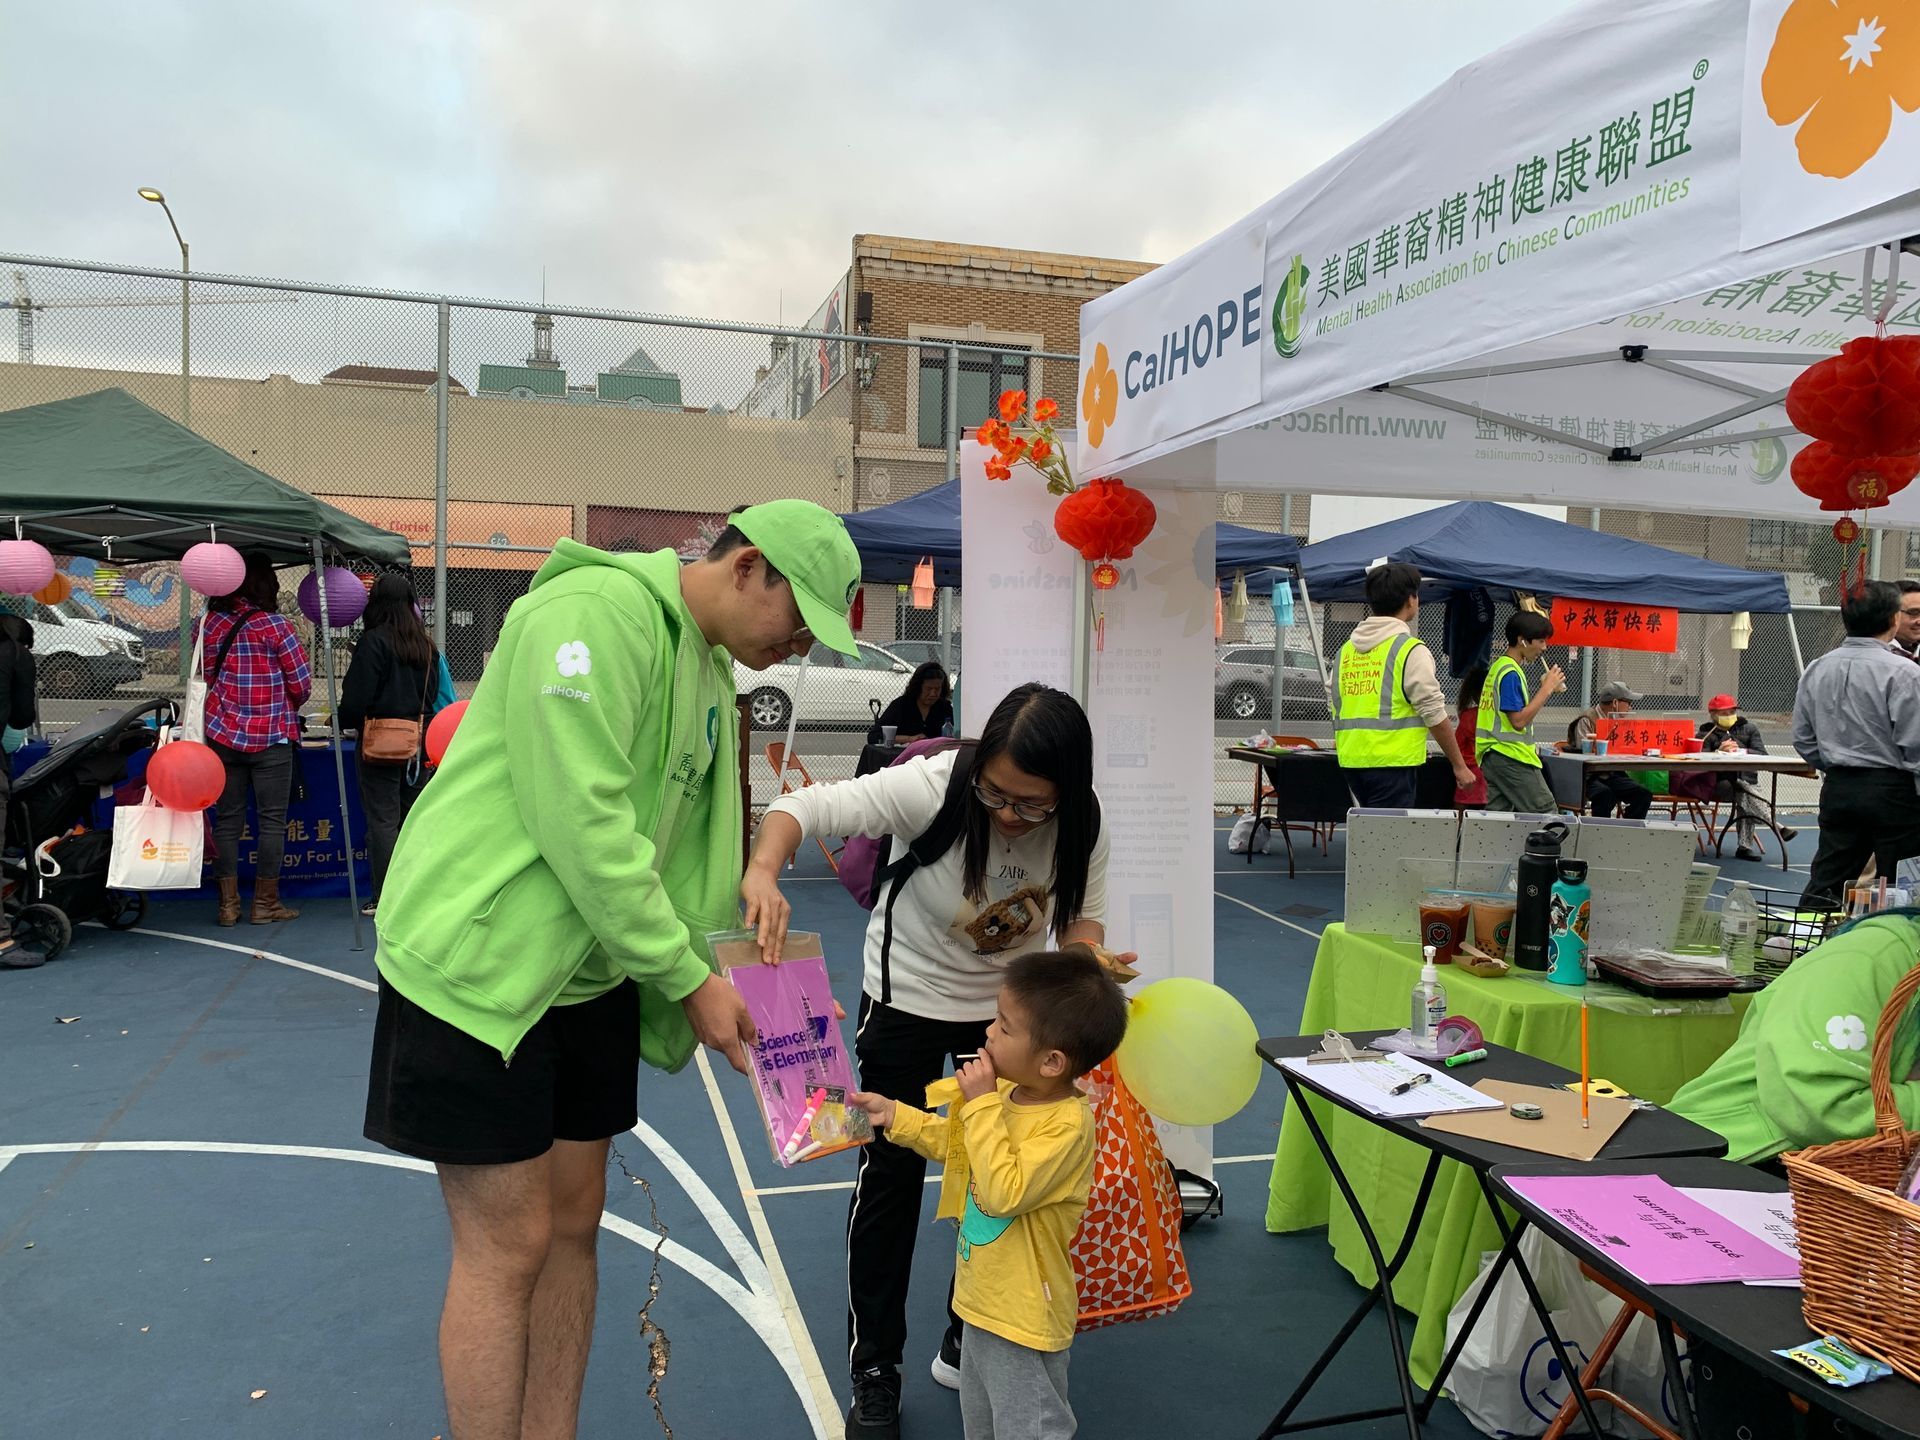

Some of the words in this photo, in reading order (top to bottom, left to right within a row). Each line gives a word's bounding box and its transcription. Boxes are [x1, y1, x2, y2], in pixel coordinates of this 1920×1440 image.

[1317, 86, 1695, 308] 美國華裔精神健康聯盟
[1315, 304, 1352, 336] Mental
[1356, 288, 1392, 321] Health
[1396, 261, 1468, 306] Association
[1473, 250, 1493, 275] for
[1497, 227, 1558, 265] Chinese
[1564, 176, 1690, 240] Communities
[1124, 283, 1262, 399] CalHOPE
[1857, 478, 1878, 498] 福
[1563, 606, 1662, 634] 中秋節快樂
[1608, 729, 1684, 747] 中秋节快乐
[306, 850, 332, 863] For
[337, 847, 368, 861] Lfe!
[759, 1030, 806, 1053] Science
[775, 1045, 837, 1070] Elementary
[1563, 1208, 1598, 1231] Science
[1633, 1194, 1686, 1225] Jasmine
[1705, 1240, 1744, 1258] José
[1766, 1208, 1793, 1226] Jasm
